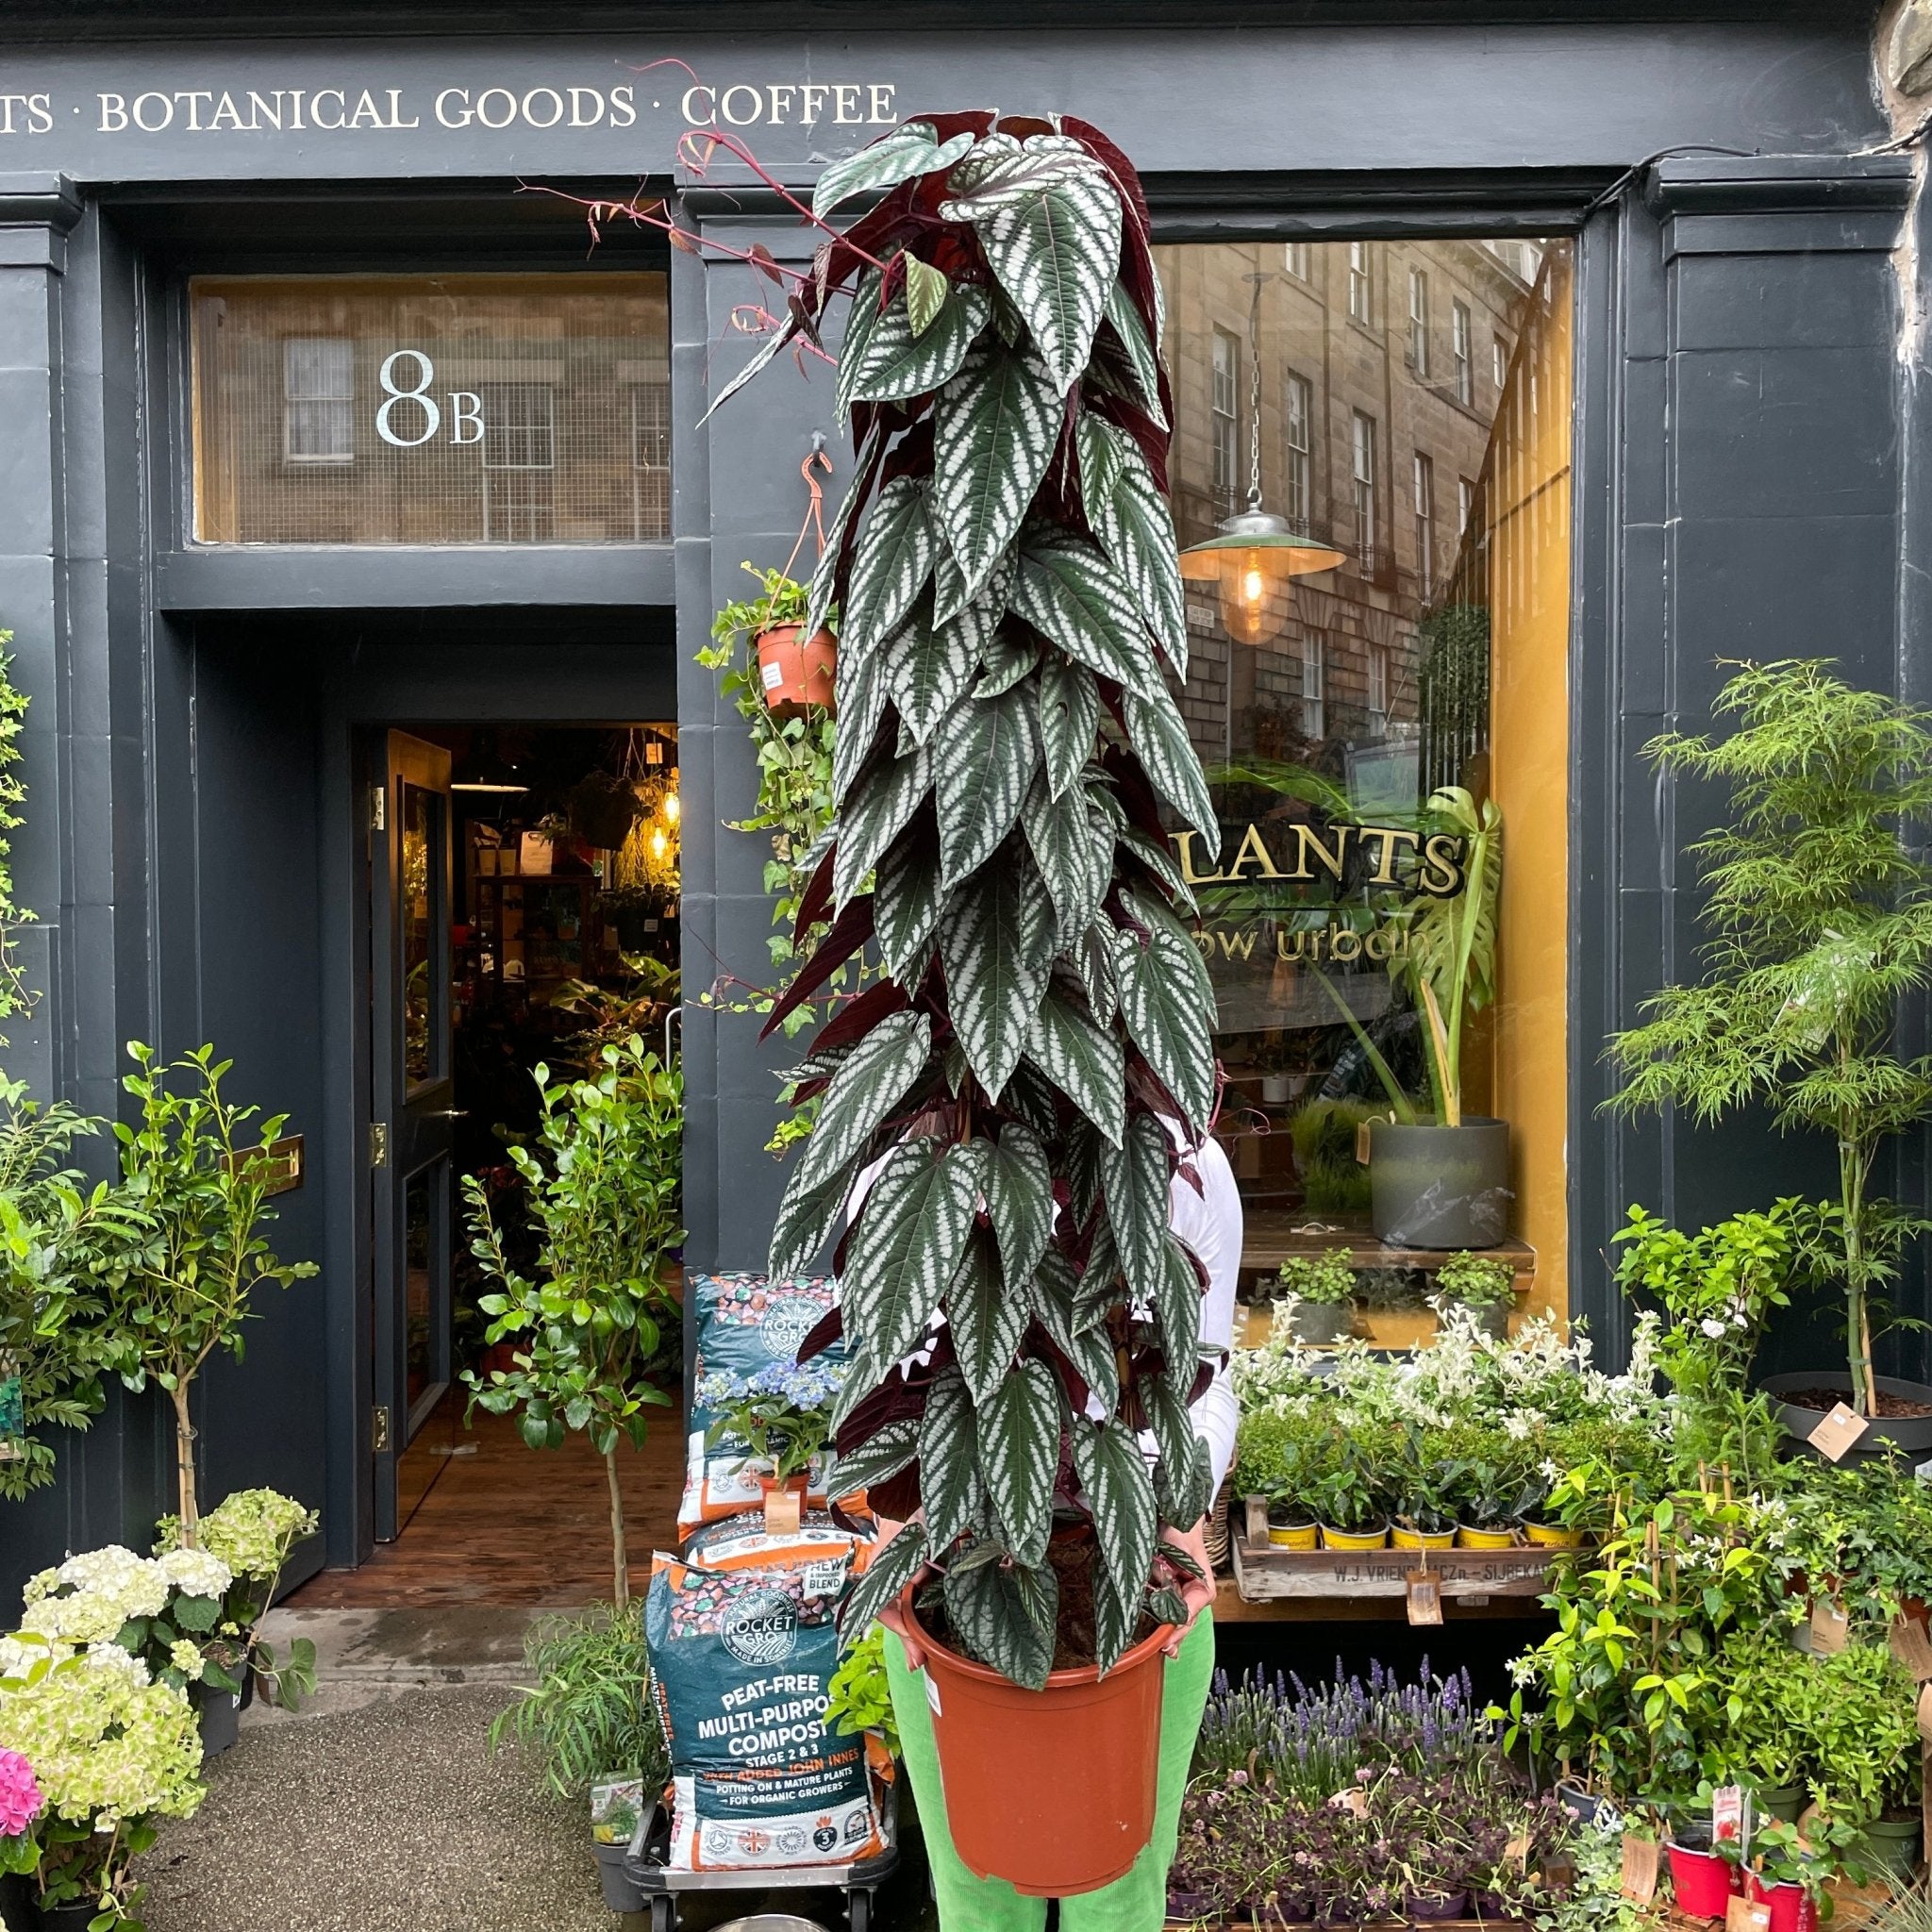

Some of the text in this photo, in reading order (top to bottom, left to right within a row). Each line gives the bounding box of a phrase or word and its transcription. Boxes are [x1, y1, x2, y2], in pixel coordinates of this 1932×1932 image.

[96, 89, 420, 132] BOTANICAL
[435, 86, 637, 129] GOODS
[681, 84, 898, 125] COFFEE
[1276, 921, 1431, 962] urban
[795, 1298, 825, 1318] GOODNE
[809, 1578, 841, 1589] BLEND
[728, 1591, 794, 1617] NATURAL GOODNESS
[725, 1616, 793, 1635] ROCKET
[743, 1631, 778, 1644] GRO
[730, 1646, 752, 1662] MADE
[763, 1640, 793, 1663] SOMERSET
[721, 1674, 820, 1712] PEAT-FREE
[698, 1694, 836, 1740] MULTI-PURPO
[728, 1718, 828, 1757] COMPOST
[737, 1768, 783, 1782] ADDED
[789, 1757, 824, 1775] JOHN
[828, 1747, 860, 1767] INNES
[745, 1743, 819, 1769] STAGE 2 & 3
[716, 1766, 854, 1794] POTTING ON & MATURE PLANTS
[729, 1781, 843, 1806] FOR ORGANIC GROWERS
[822, 1832, 830, 1845] 3
